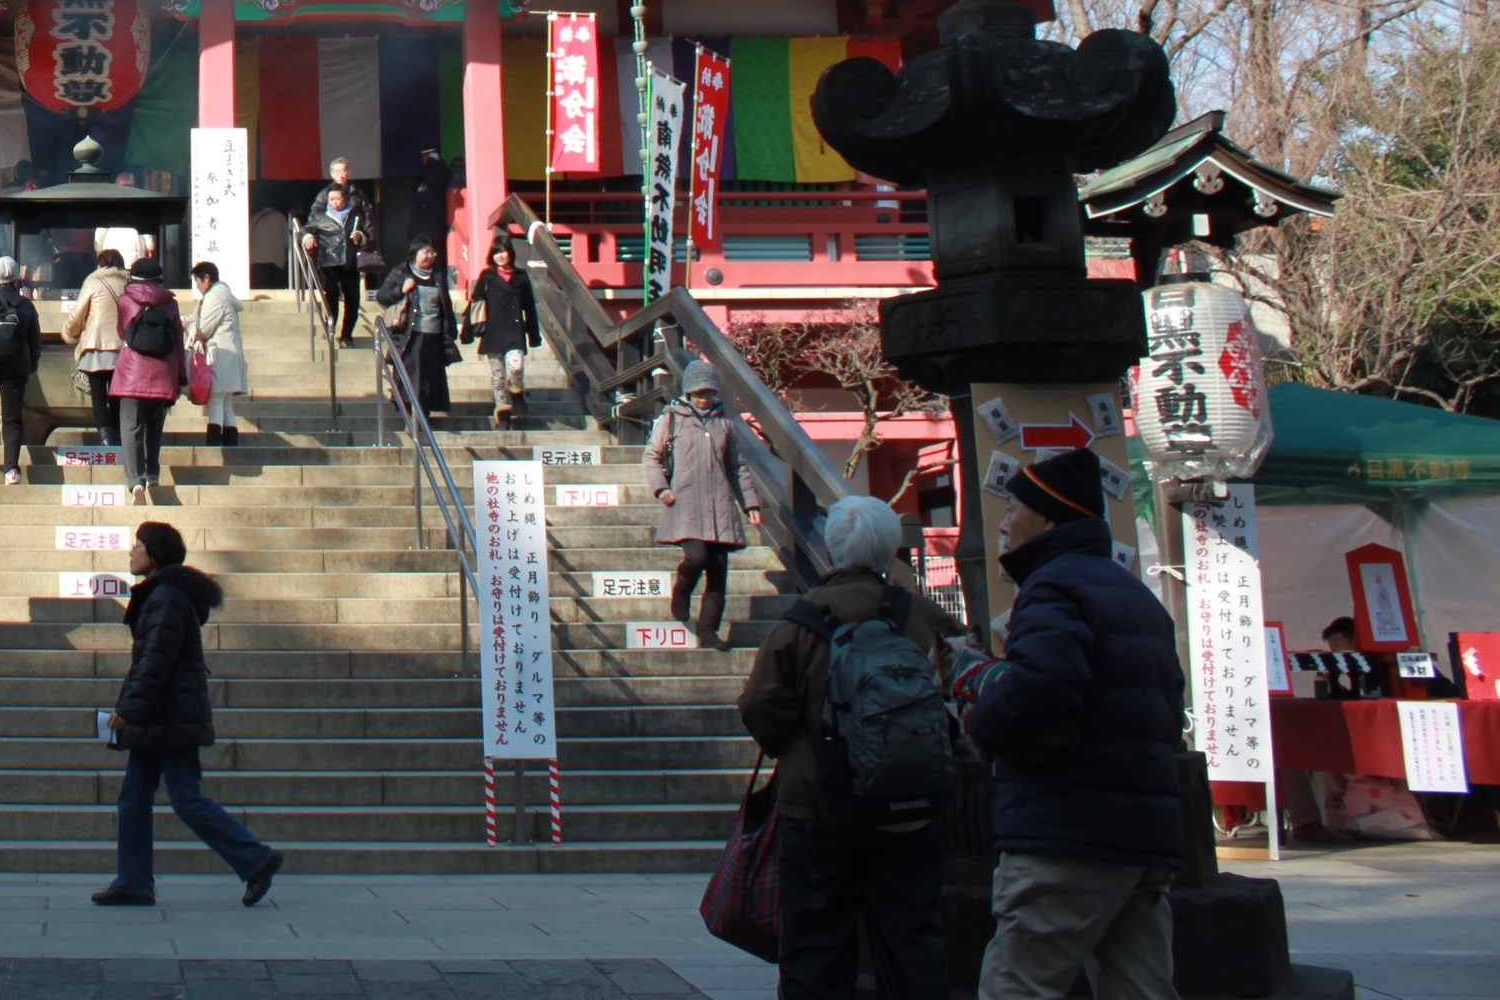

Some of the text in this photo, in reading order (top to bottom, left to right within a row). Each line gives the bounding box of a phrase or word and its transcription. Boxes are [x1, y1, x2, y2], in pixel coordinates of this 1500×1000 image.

[65, 451, 117, 466] 足元注意
[541, 451, 593, 465] 足元注意
[1367, 458, 1472, 480] 目黒不動尊
[64, 533, 121, 549] 足元注意
[603, 578, 662, 596] 足元注意
[485, 472, 509, 746] 他の社寺のお札・お守りは受付けておりません
[504, 473, 527, 733] お焚上げは受付けておりません
[523, 473, 546, 745] しめ縄・正月飾り・ダルマ等の
[1233, 497, 1260, 769] しめ縄・正月飾り・ダルマ等の
